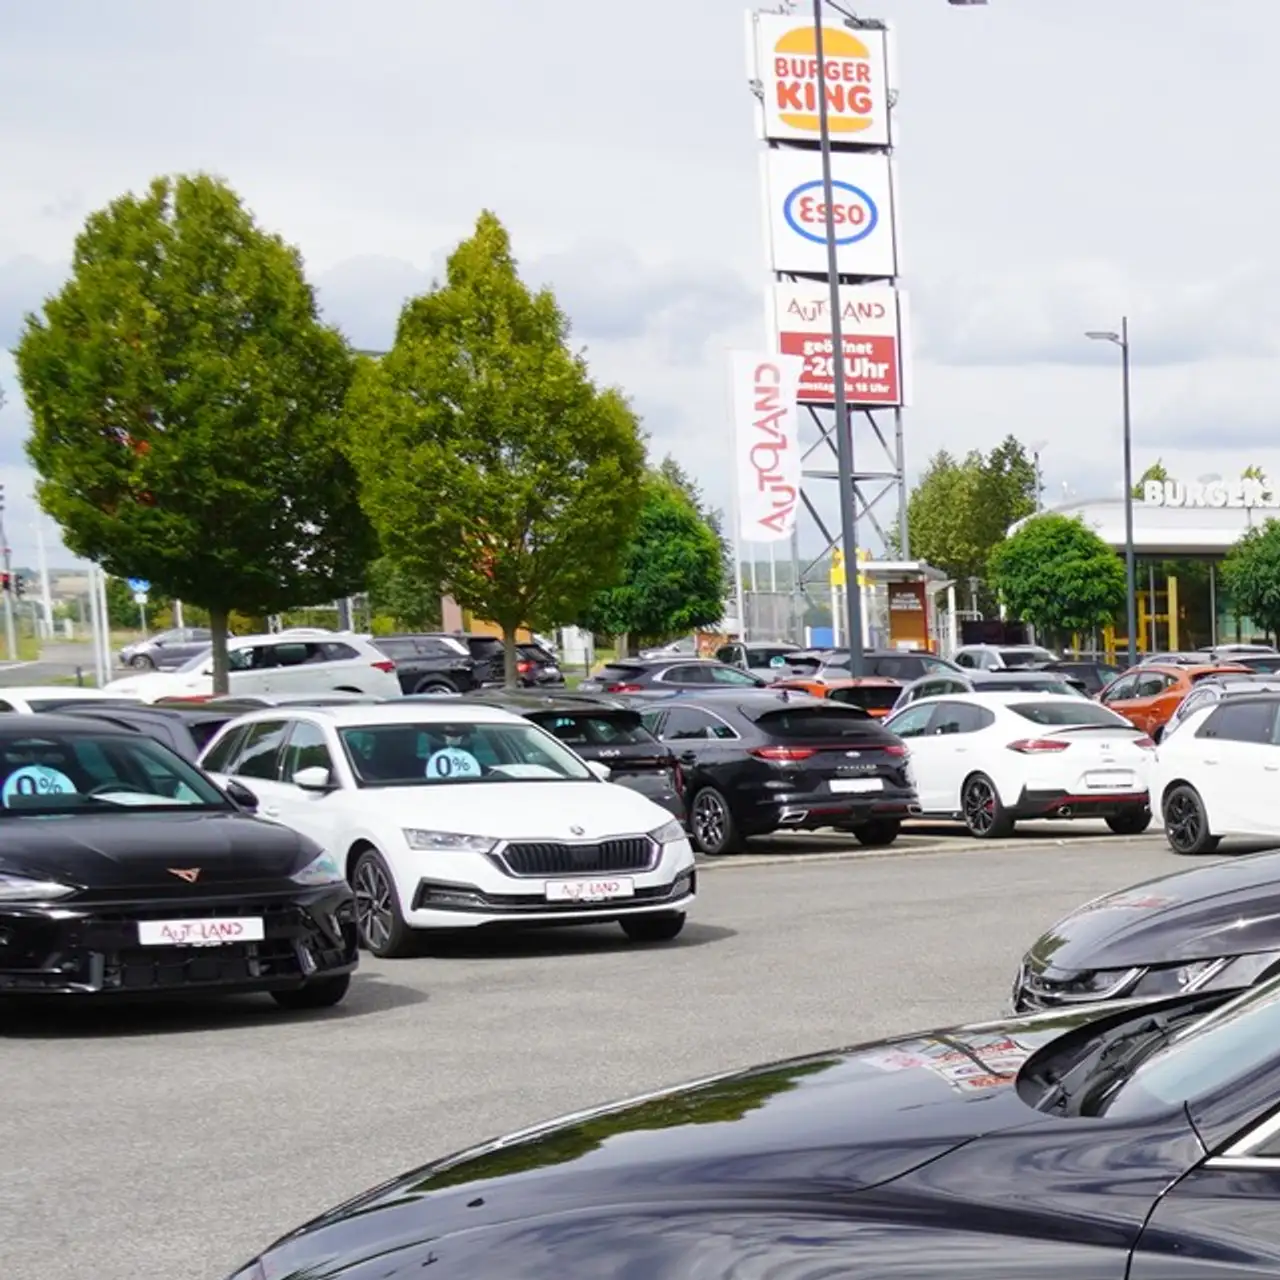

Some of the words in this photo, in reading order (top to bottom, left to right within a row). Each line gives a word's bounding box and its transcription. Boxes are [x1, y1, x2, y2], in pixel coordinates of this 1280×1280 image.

[774, 57, 871, 83] BURGER
[776, 80, 873, 115] KING
[844, 356, 890, 379] Uhr
[749, 363, 797, 534] AUTOLAND
